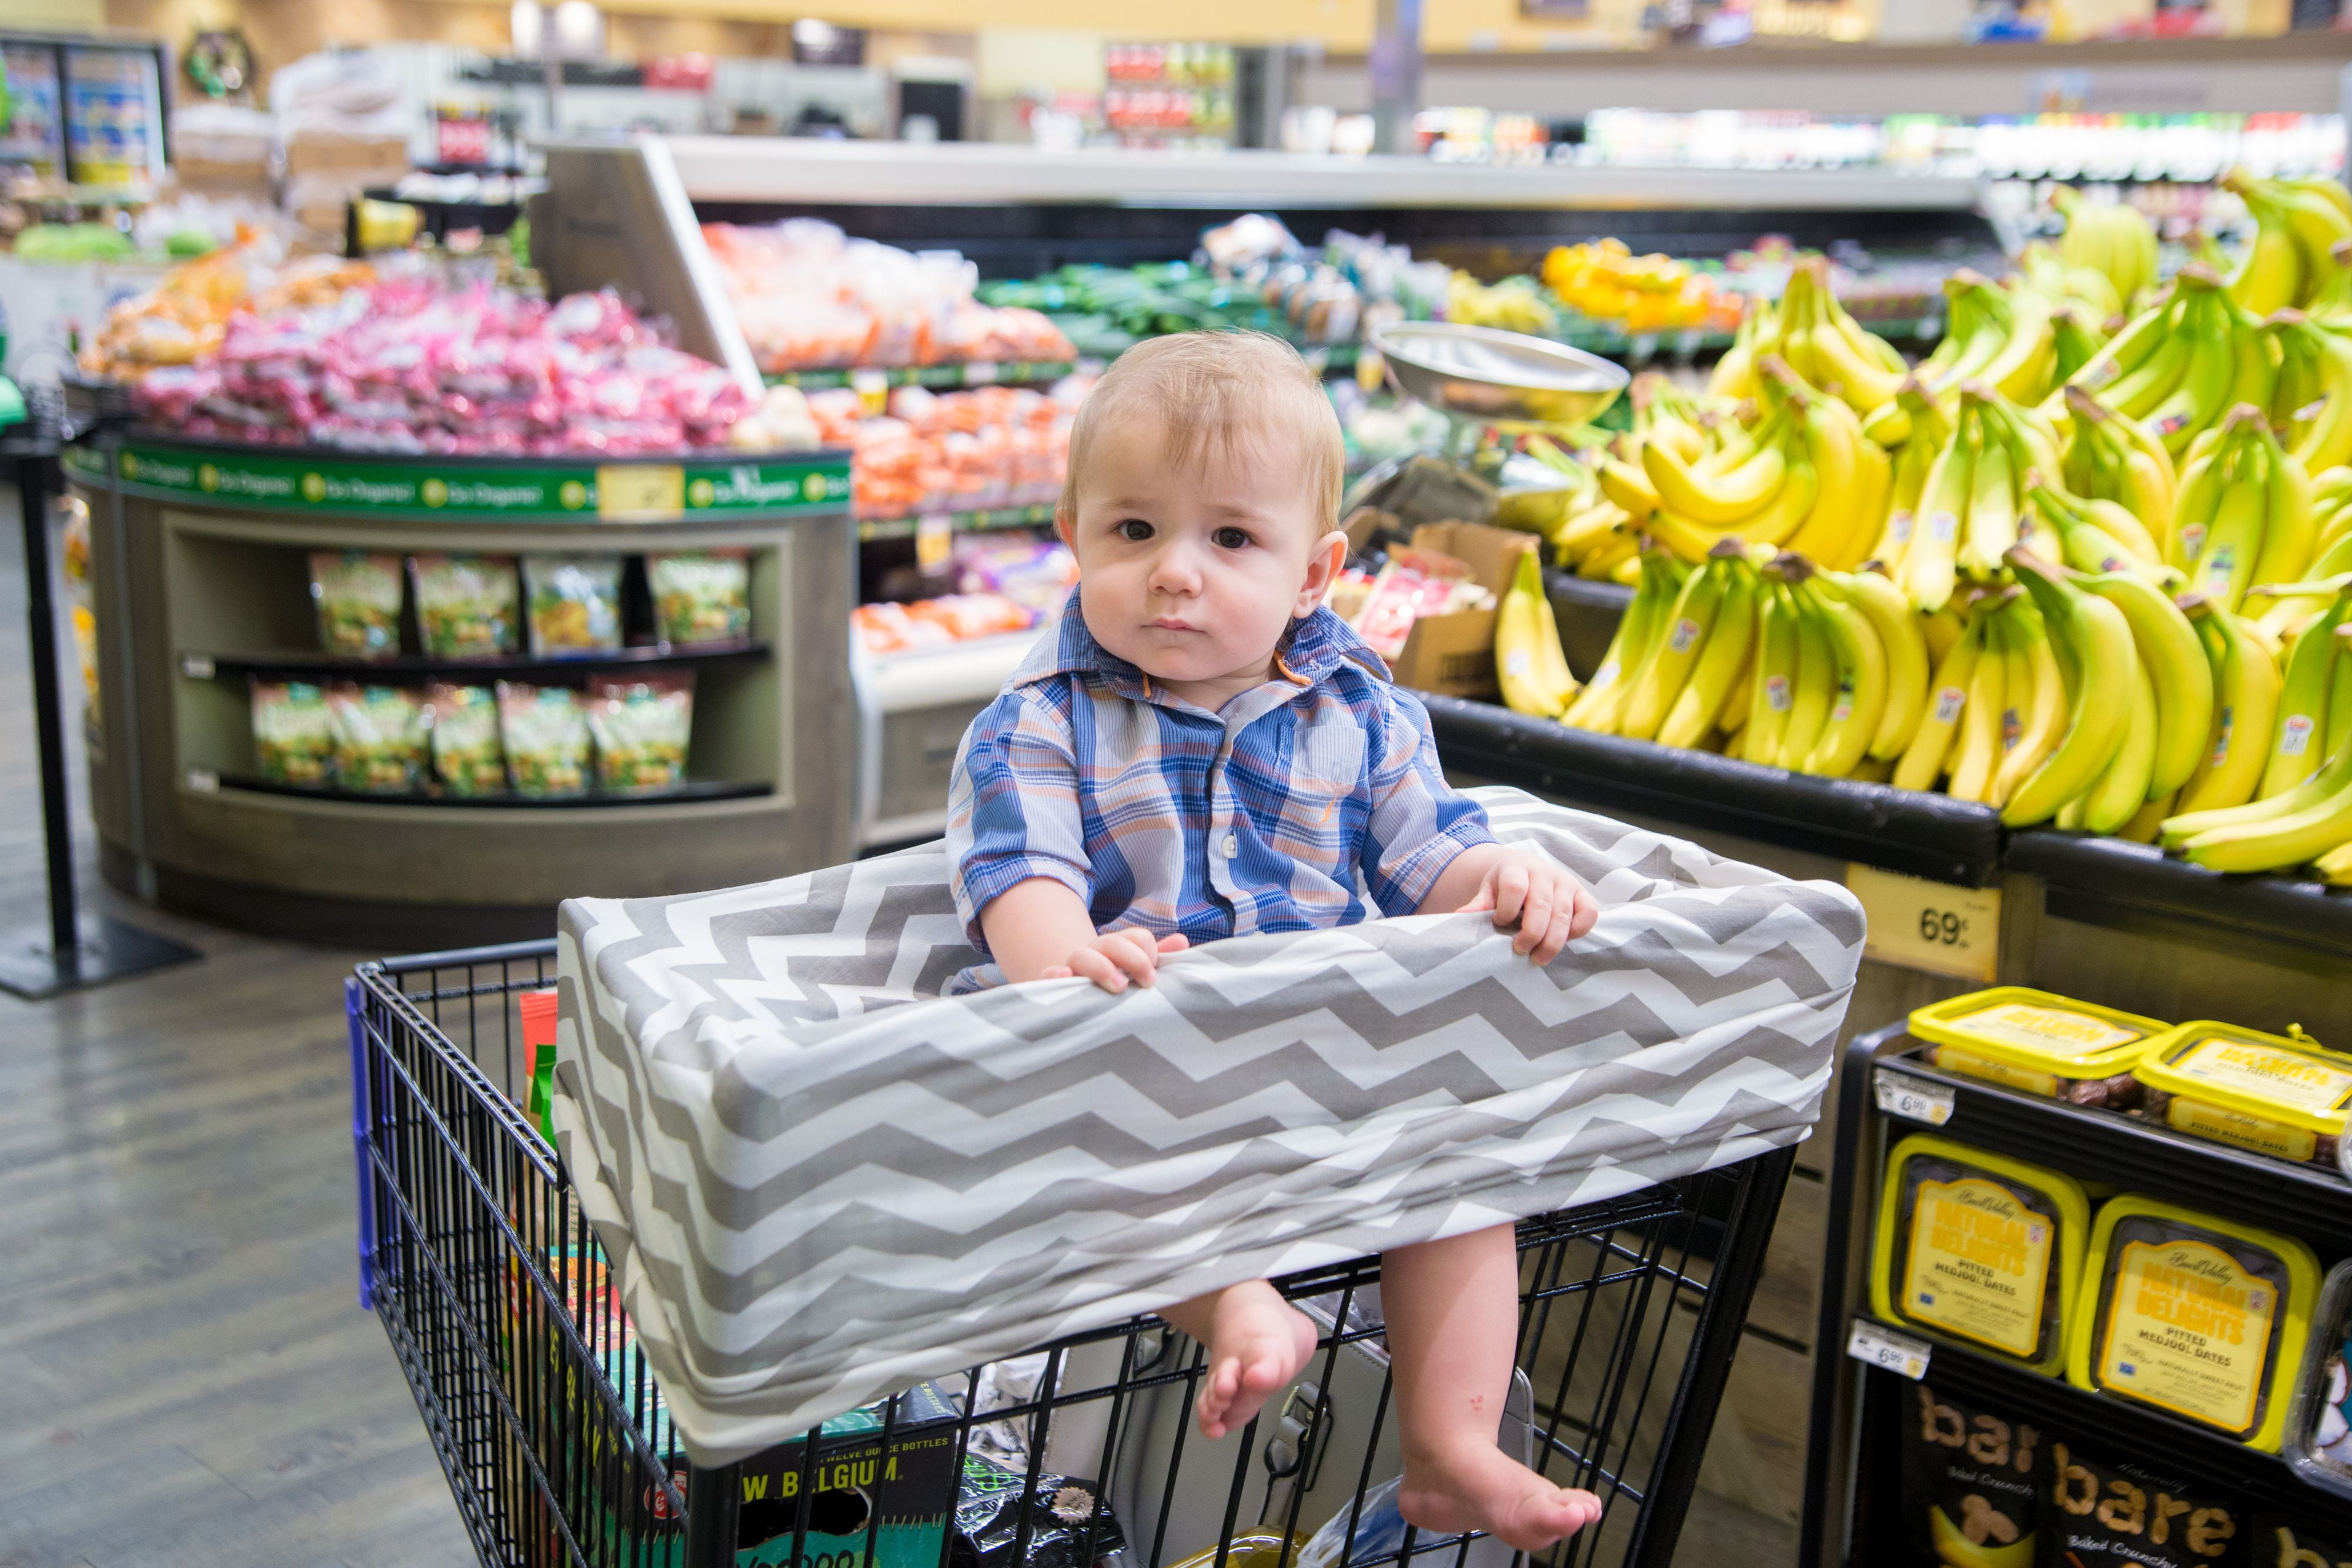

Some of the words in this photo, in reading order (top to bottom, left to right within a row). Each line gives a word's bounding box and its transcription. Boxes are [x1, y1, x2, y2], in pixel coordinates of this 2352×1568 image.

[1934, 1262, 1982, 1285] MEDJOOL
[1983, 1278, 2017, 1296] DATES
[1958, 1259, 1994, 1278] PITTED
[2136, 1290, 2246, 1345] DELIGHTS
[2139, 1328, 2193, 1355] MEDJOOL
[2194, 1348, 2233, 1367] DATES
[2166, 1326, 2207, 1347] PITTED
[2157, 1358, 2199, 1376] NATURALLY
[2200, 1372, 2225, 1385] SWEET
[1918, 1384, 2039, 1473] bar
[820, 1449, 863, 1463] WELVE
[865, 1443, 899, 1457] OUE
[902, 1437, 948, 1452] BOTTLES
[782, 1456, 898, 1497] BLGIUM
[1977, 1473, 2034, 1498] Crunch
[2052, 1442, 2237, 1558] bare
[2067, 1534, 2109, 1552] Baked
